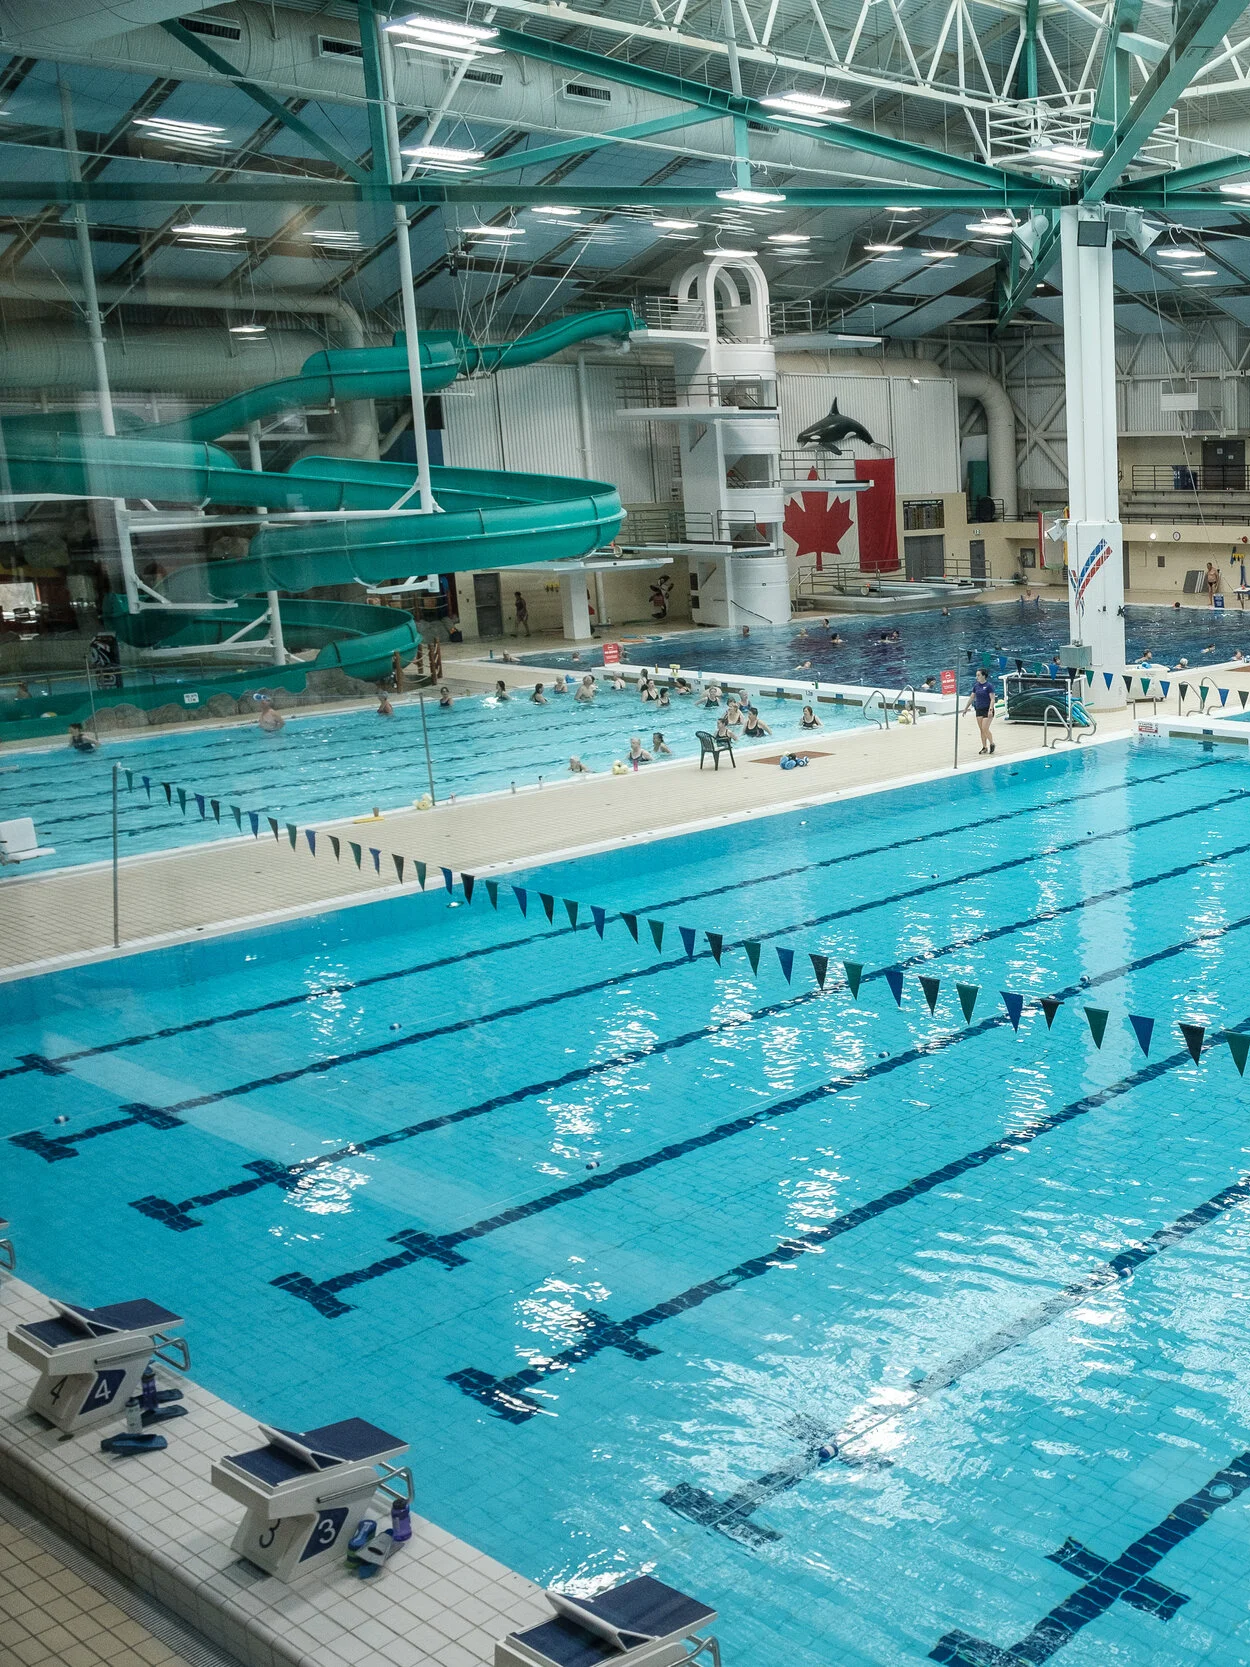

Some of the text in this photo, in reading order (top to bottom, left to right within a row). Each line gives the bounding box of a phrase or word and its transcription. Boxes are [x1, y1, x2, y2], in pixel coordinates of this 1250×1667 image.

[50, 1375, 69, 1405] 4
[94, 1379, 112, 1400] 4
[317, 1518, 337, 1545] 3
